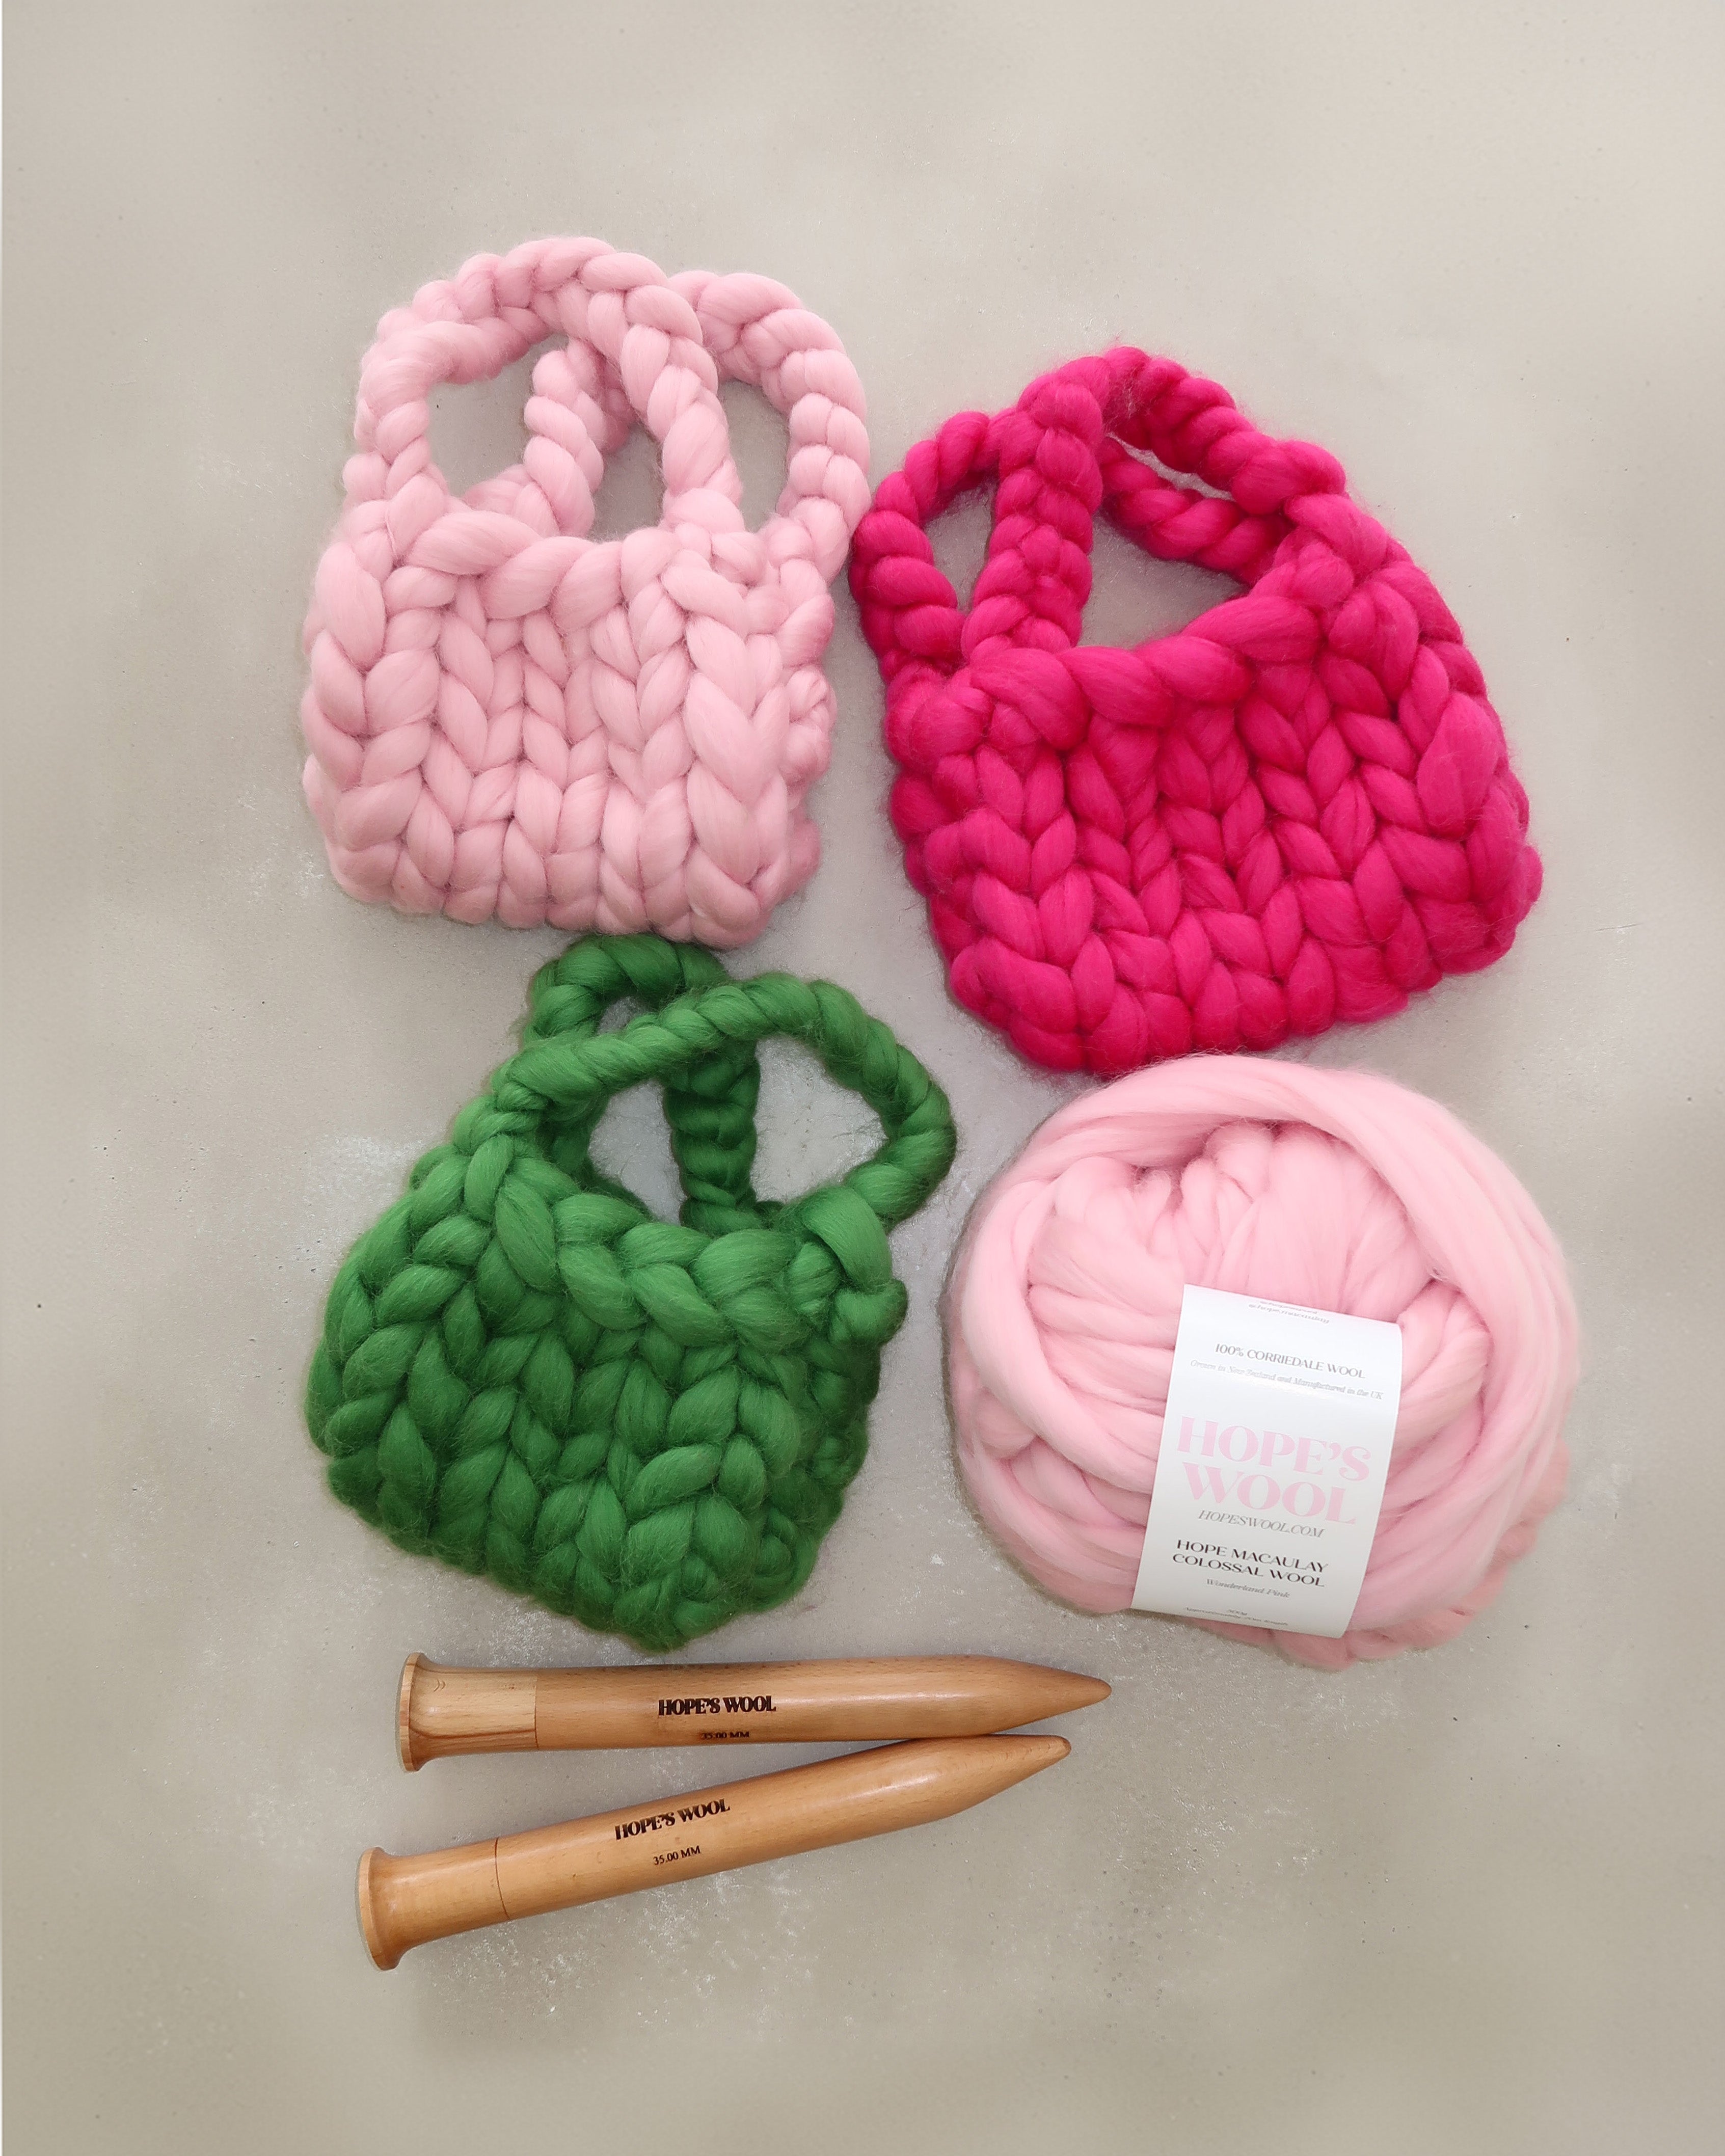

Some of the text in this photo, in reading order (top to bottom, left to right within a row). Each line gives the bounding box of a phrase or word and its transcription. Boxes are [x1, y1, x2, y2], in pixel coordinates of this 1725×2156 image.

[1216, 1343, 1366, 1379] 100% CORRIEDALE WOOL
[1190, 1360, 1216, 1370] Grown
[1228, 1366, 1246, 1375] New
[1245, 1369, 1276, 1381] Zealand
[1277, 1373, 1292, 1383] and
[1293, 1377, 1346, 1393] Manufactured
[1356, 1388, 1369, 1397] the
[1370, 1391, 1384, 1400] UK
[1177, 1416, 1371, 1481] HOPE'S
[1182, 1462, 1356, 1525] WOOL
[1198, 1510, 1325, 1538] HOPESWOOL.COM
[1172, 1553, 1325, 1587] COLOSSAL WOOL
[1177, 1540, 1328, 1573] HOPE MACAULAY
[1206, 1578, 1290, 1599] Wonderland Pink
[658, 1695, 776, 1716] HOPE'S WOOL
[614, 1798, 730, 1840] HOPE'S WOOL
[653, 1845, 701, 1866] 35.00 MM
